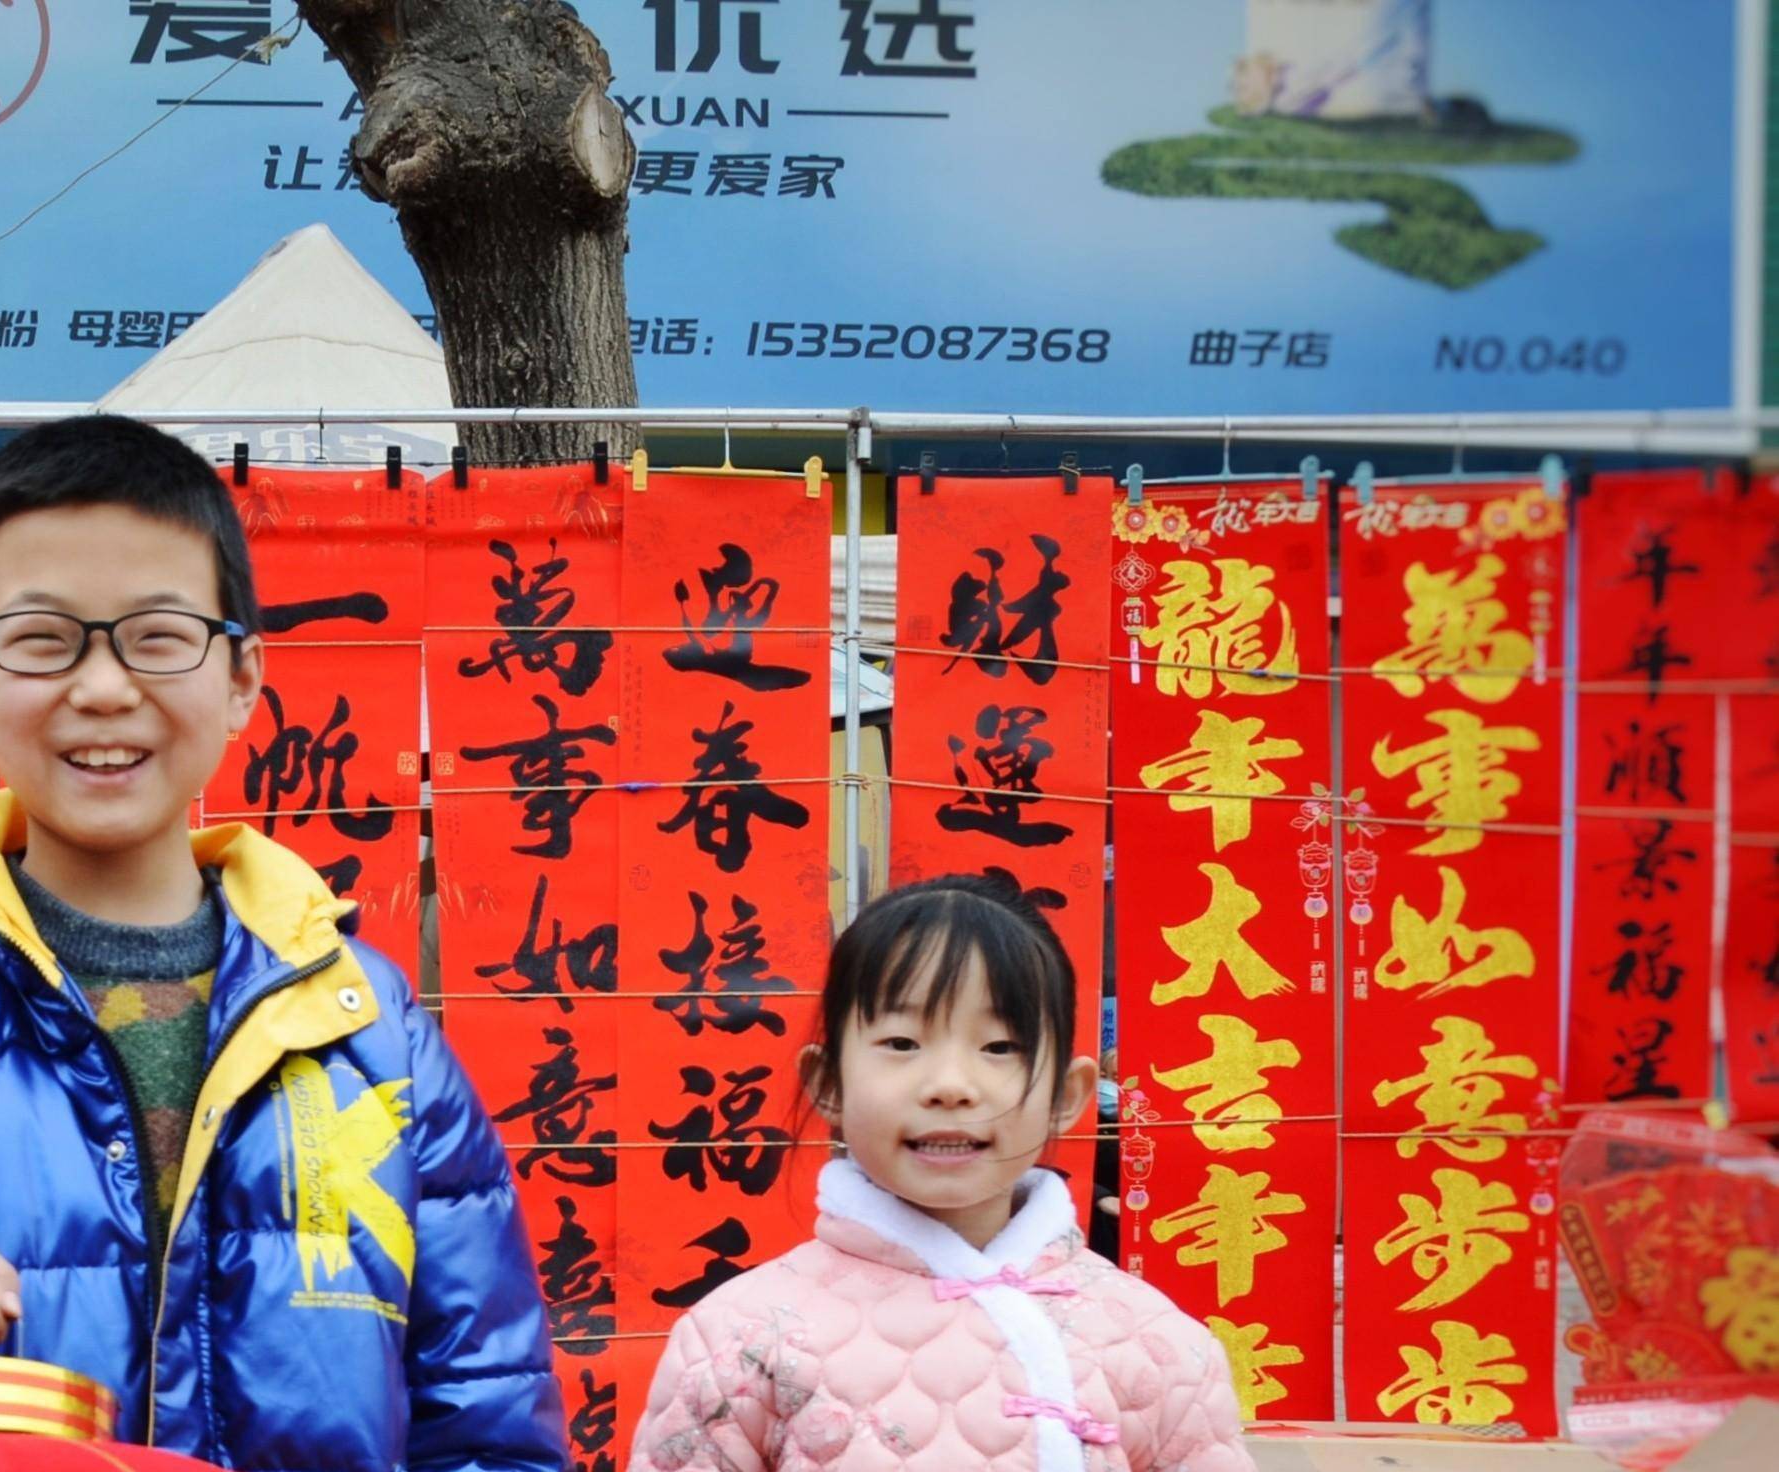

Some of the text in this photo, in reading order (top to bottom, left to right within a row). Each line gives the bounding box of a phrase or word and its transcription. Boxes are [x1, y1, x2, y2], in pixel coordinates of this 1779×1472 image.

[632, 152, 845, 199] 更爱家
[745, 320, 1111, 364] 15352087368
[1189, 331, 1332, 367] 曲子店
[1434, 336, 1626, 375] NO.040
[935, 534, 1074, 910] 財運
[288, 1072, 317, 1149] DESIGN
[302, 1156, 326, 1238] FAMOUS
